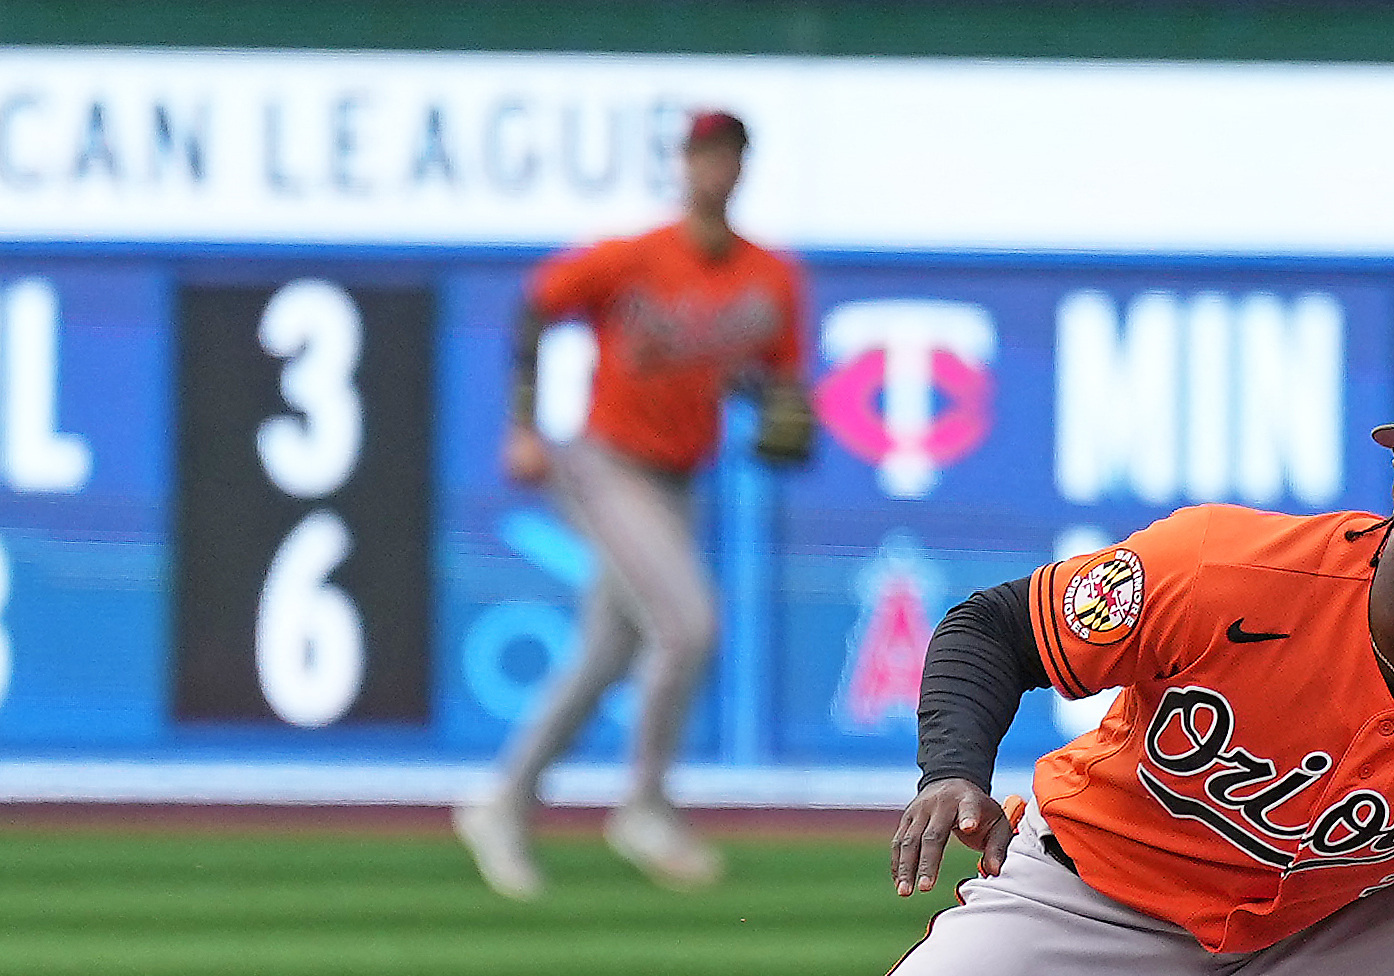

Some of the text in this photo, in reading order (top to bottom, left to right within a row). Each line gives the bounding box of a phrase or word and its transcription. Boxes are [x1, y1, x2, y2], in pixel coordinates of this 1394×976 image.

[262, 92, 690, 199] LEAGUE
[256, 278, 365, 499] 3
[1055, 286, 1343, 503] MIN
[255, 508, 366, 729] 6
[1063, 575, 1090, 639] ORIOLES
[1115, 550, 1143, 628] BALTIMORE
